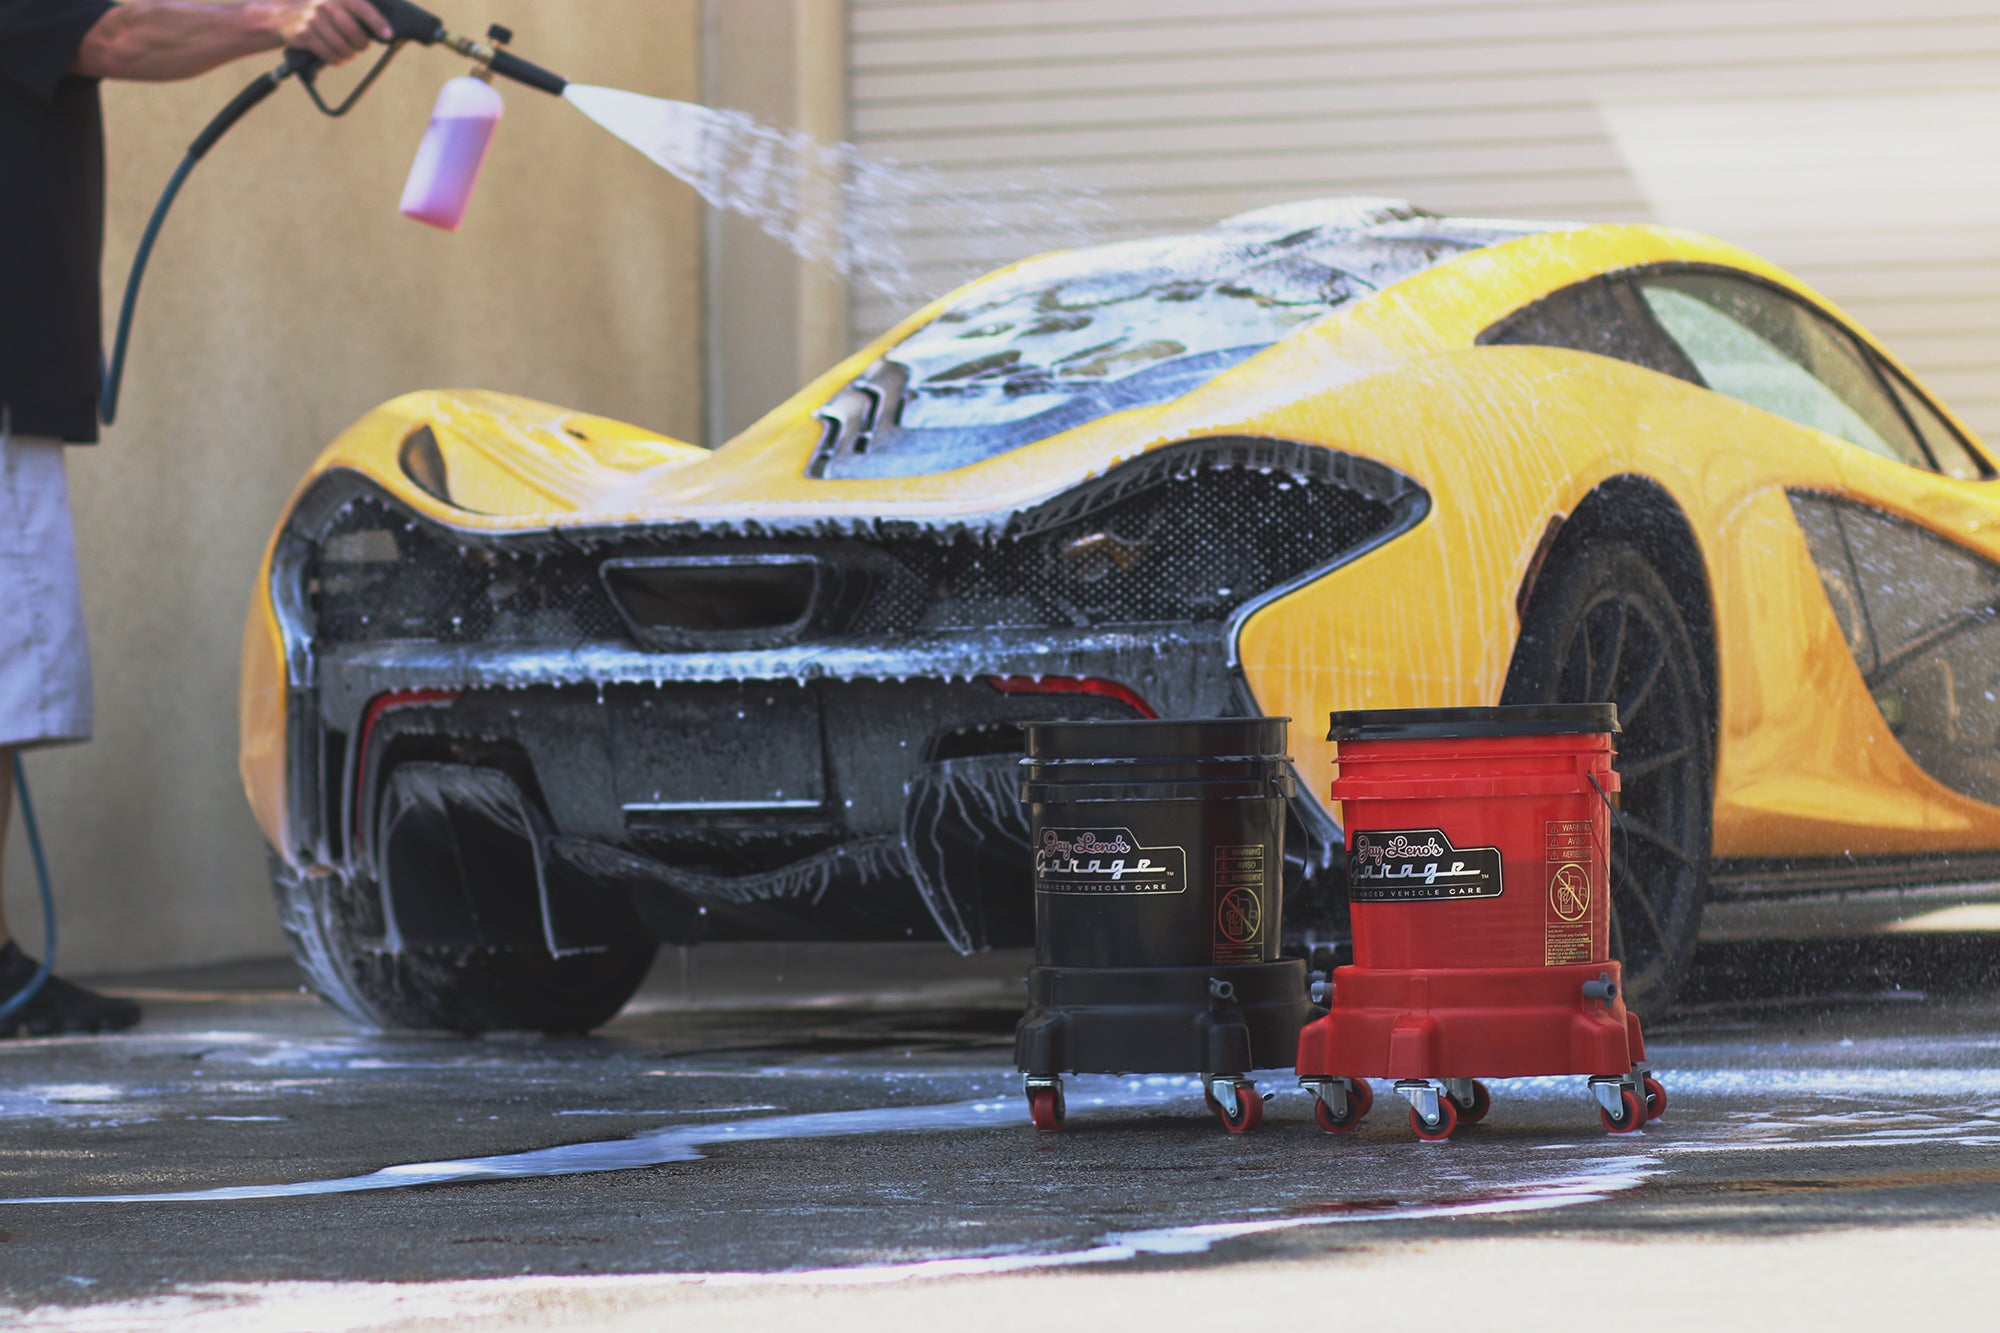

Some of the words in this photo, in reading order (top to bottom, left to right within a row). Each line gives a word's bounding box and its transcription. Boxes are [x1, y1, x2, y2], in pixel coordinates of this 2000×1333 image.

[1043, 830, 1072, 860] Jay
[1073, 832, 1131, 854] Leno's
[1231, 847, 1261, 856] WARNING
[1357, 835, 1384, 866] Jay
[1385, 835, 1444, 858] Leno's
[1036, 850, 1167, 880] Garage
[1351, 856, 1481, 886] Garage
[1077, 884, 1126, 892] VEHICLE
[1134, 883, 1167, 891] CARE
[1390, 888, 1440, 898] VEHICLE
[1449, 886, 1482, 895] CARE
